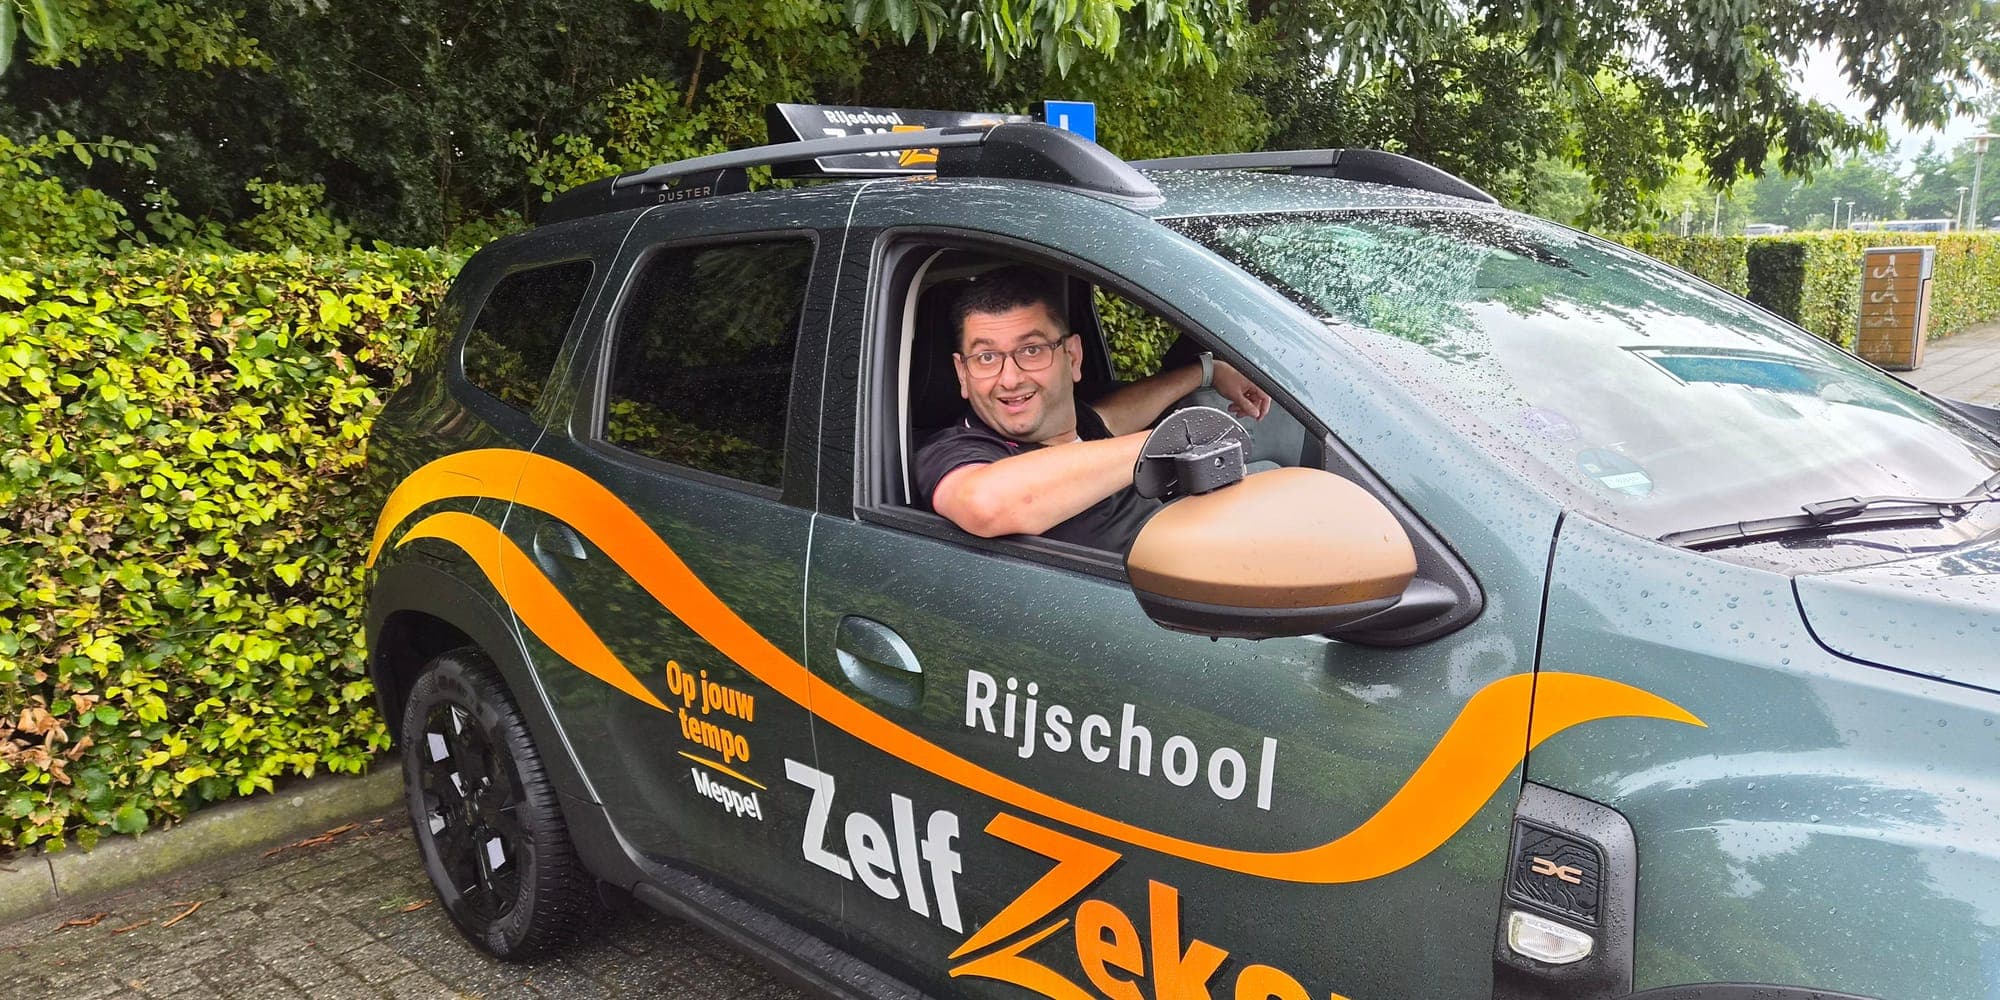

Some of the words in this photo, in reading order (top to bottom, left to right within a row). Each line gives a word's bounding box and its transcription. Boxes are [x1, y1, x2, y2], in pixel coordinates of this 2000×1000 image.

[823, 110, 904, 126] Rijschool
[658, 186, 711, 203] DUSTER
[666, 660, 696, 707] Op
[701, 670, 754, 722] jouw
[679, 709, 750, 764] tempo
[966, 669, 1278, 811] Rijschool
[690, 767, 763, 821] Meppel
